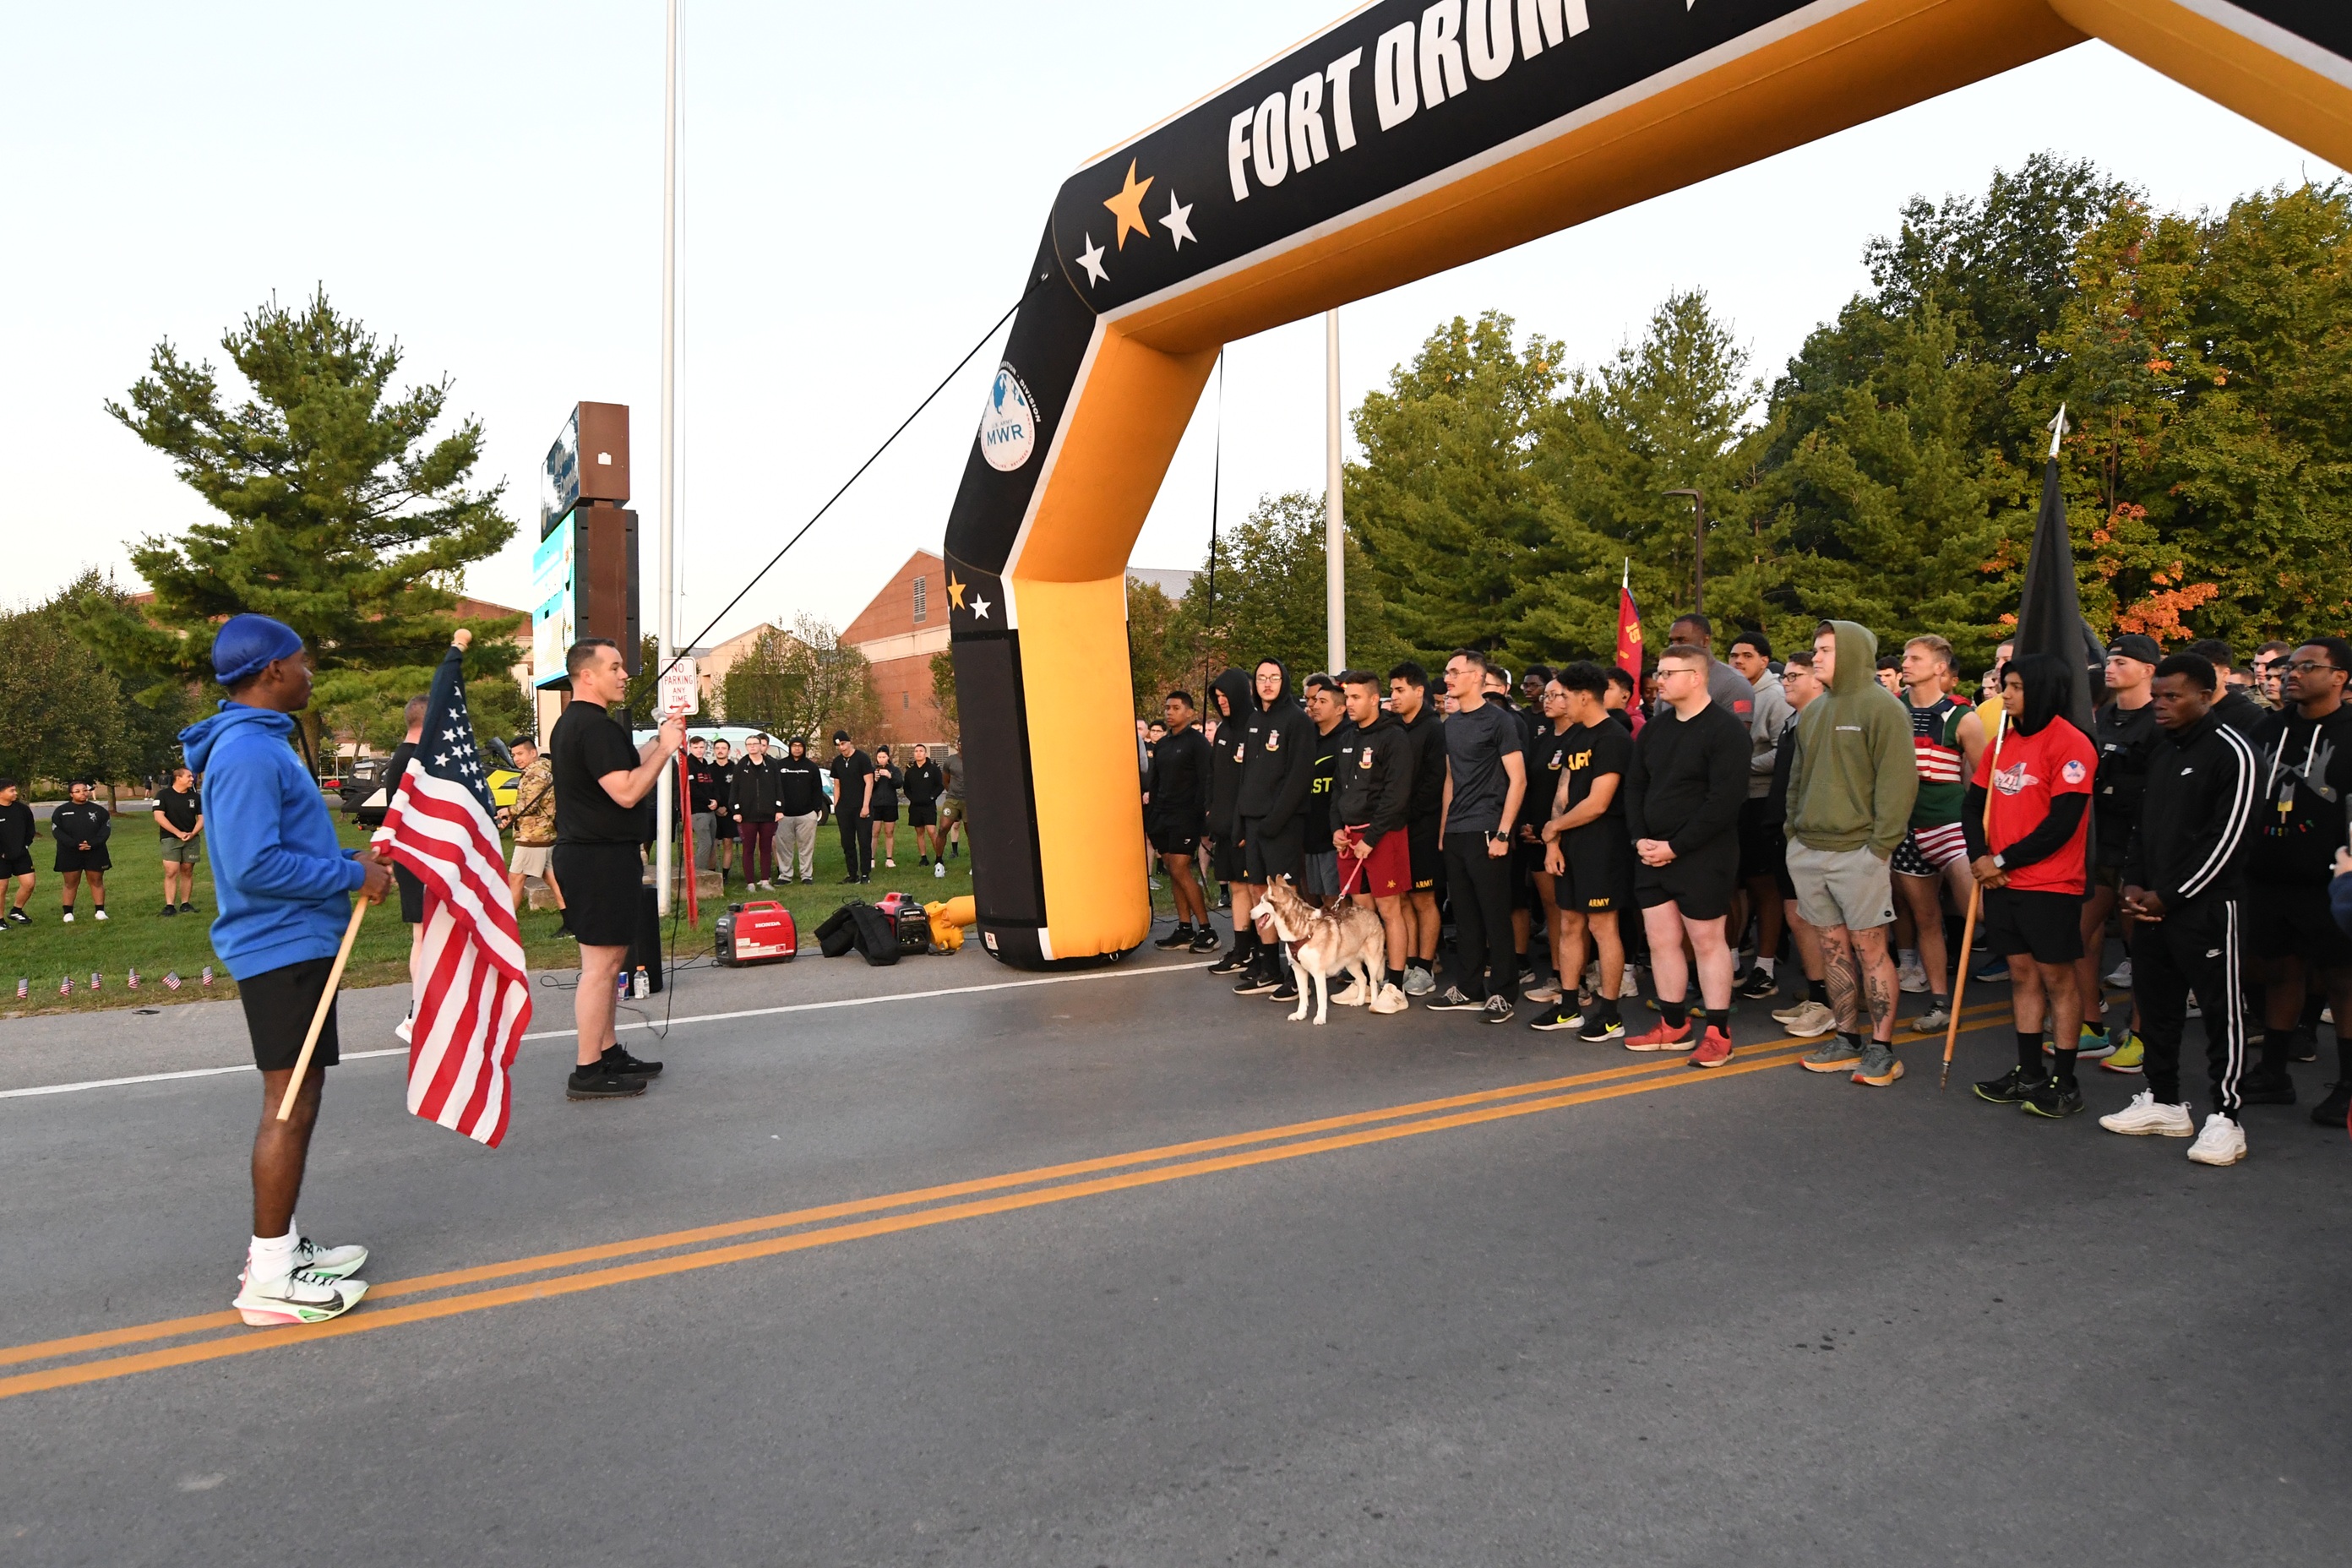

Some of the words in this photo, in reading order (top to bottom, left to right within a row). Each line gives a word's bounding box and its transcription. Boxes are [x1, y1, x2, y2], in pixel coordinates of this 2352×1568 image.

[1227, 46, 1363, 203] FORT
[1019, 378, 1042, 423] DIVISION
[987, 423, 1025, 446] MWR
[1625, 622, 1642, 644] 15
[671, 662, 684, 673] NO
[664, 674, 694, 685] PARKING
[672, 694, 688, 703] TIME
[1415, 879, 1434, 889] ARMY
[1588, 897, 1610, 907] ARMY
